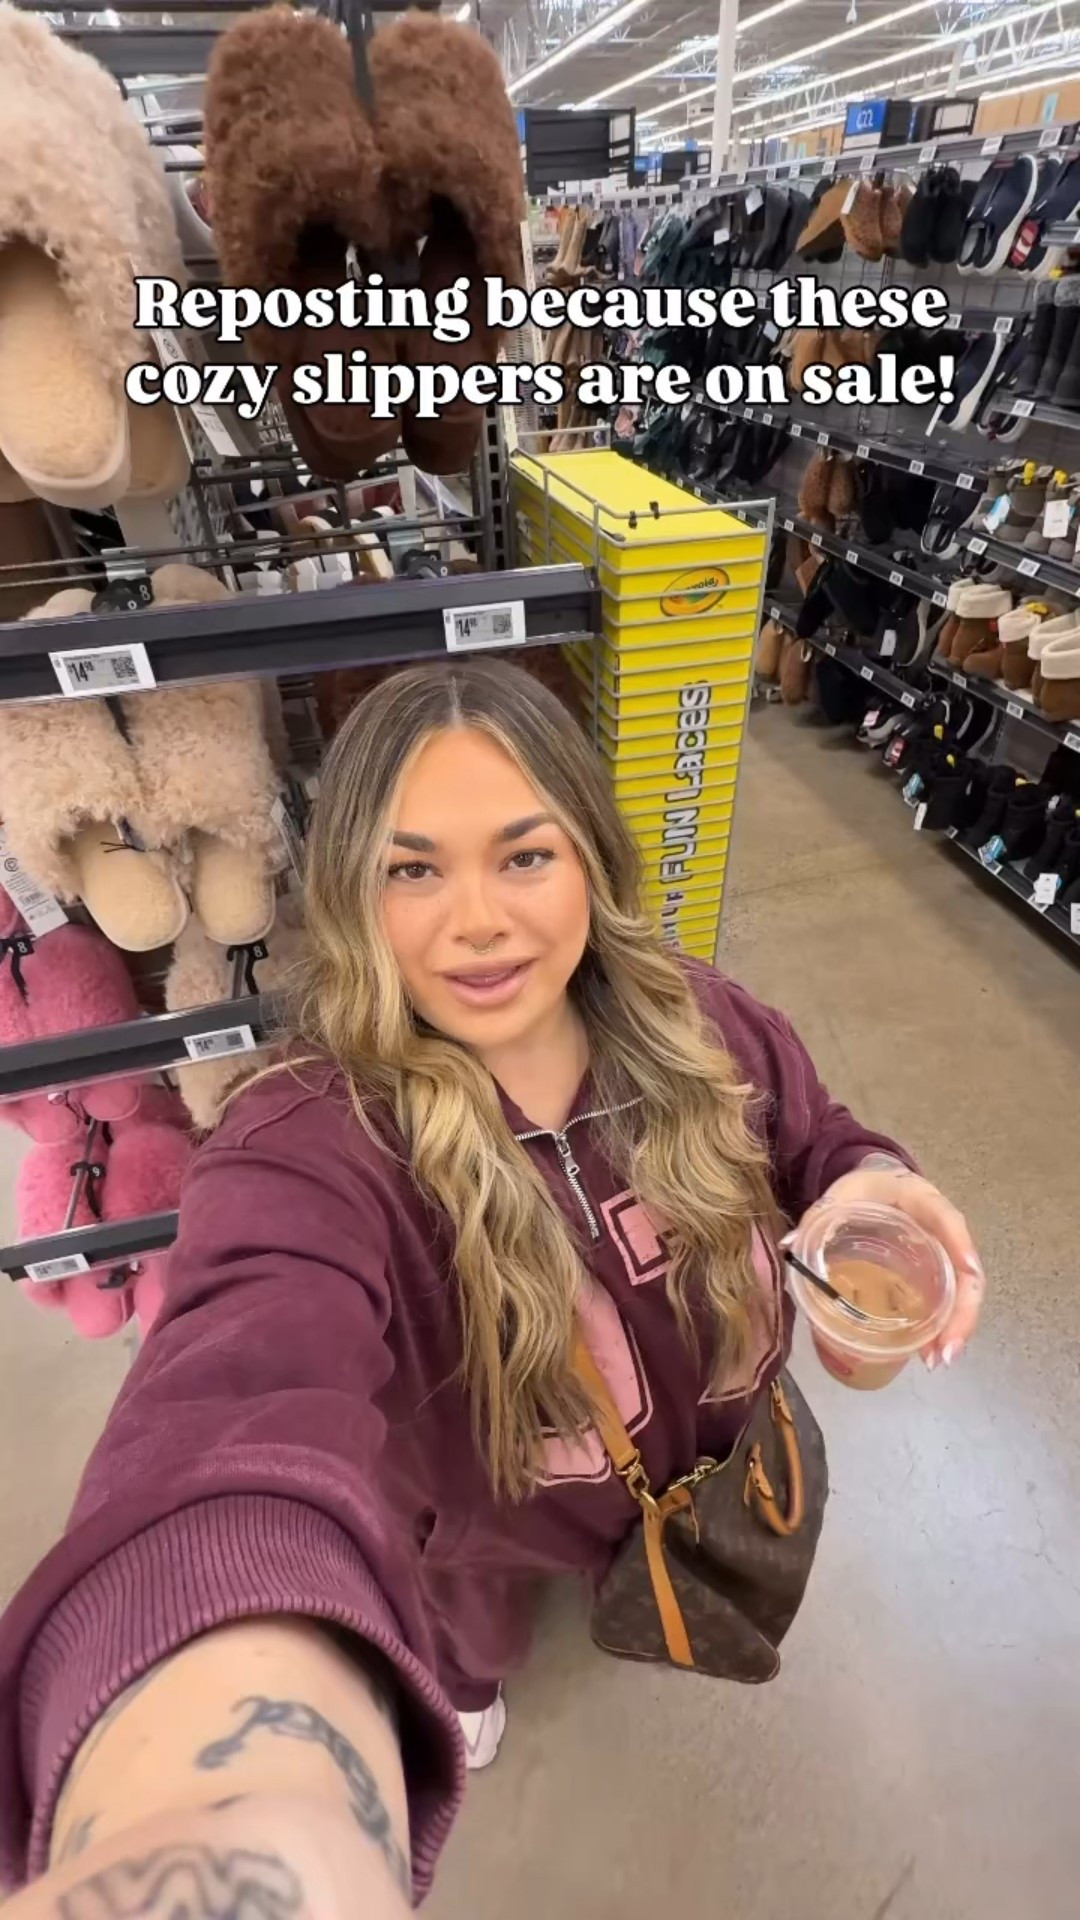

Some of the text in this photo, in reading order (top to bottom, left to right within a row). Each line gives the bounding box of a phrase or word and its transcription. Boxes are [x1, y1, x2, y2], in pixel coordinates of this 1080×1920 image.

[664, 680, 711, 804] Laces
[660, 807, 700, 884] FUN
[17, 941, 28, 954] 8
[253, 945, 263, 957] 8
